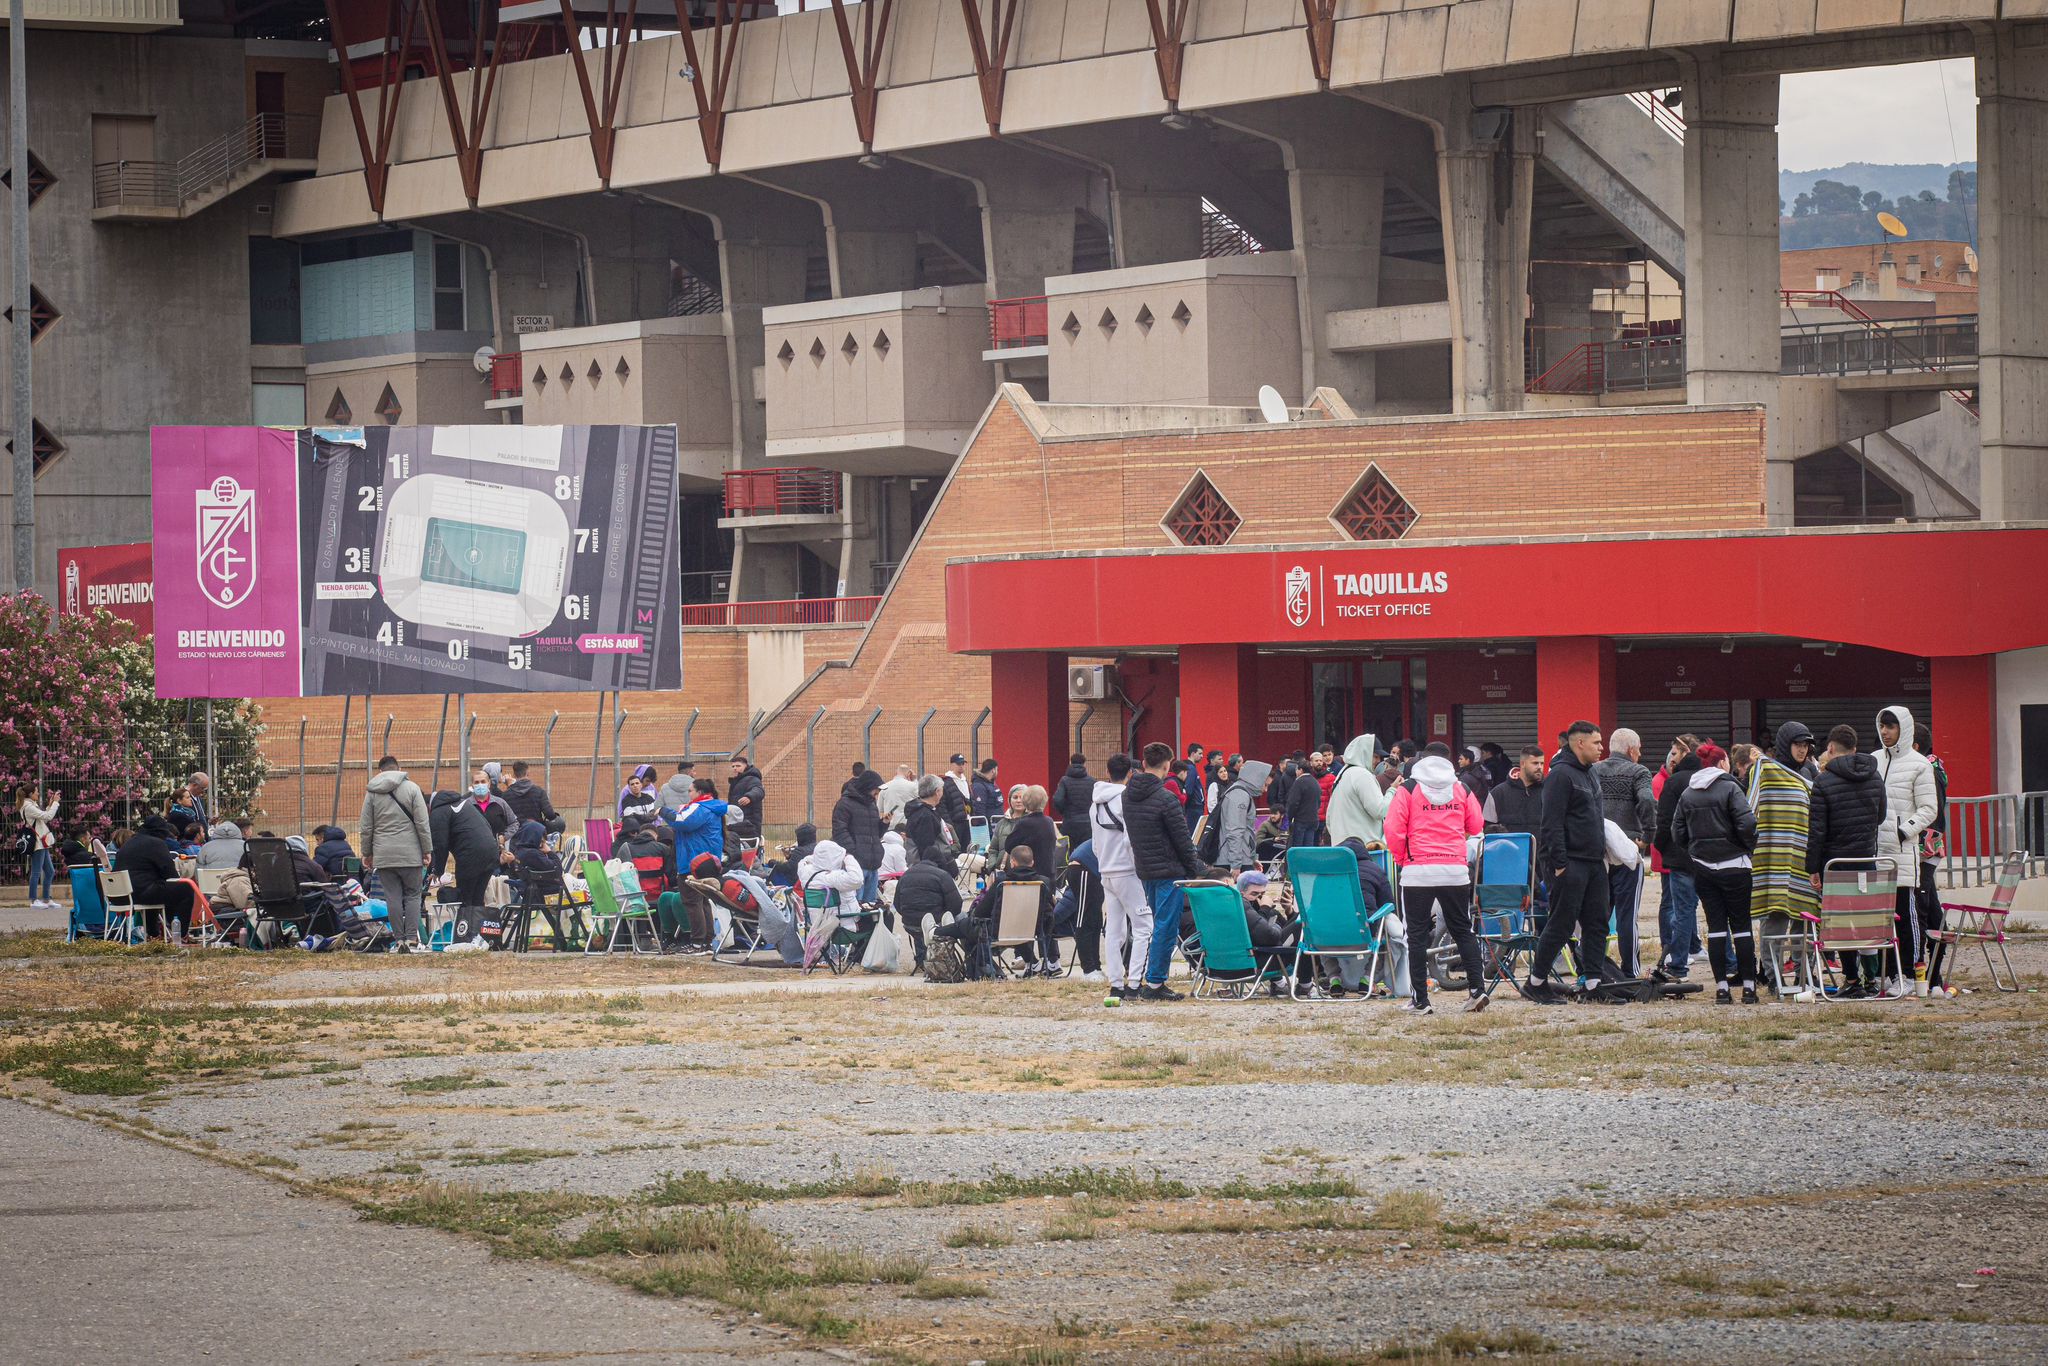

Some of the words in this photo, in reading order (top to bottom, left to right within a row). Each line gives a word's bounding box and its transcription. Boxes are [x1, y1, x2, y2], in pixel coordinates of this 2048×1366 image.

[516, 316, 543, 325] SECTOR
[544, 317, 550, 325] A
[388, 454, 400, 478] 1
[358, 486, 376, 512] 2
[554, 475, 571, 500] 8
[616, 462, 628, 512] COMARES
[322, 504, 337, 569] C/SALVADOR
[332, 456, 344, 501] ALLENDE
[614, 516, 622, 530] DE
[574, 528, 590, 554] 7
[344, 547, 361, 573] 3
[608, 534, 622, 578] C/TORRE
[1334, 571, 1448, 598] TAQUILLAS
[564, 594, 580, 620] 6
[1336, 604, 1382, 618] TICKET
[1384, 603, 1432, 616] OFFICE
[178, 629, 285, 648] BIENVENIDO
[376, 622, 394, 646] 4
[536, 637, 573, 645] TAQUILLA
[584, 636, 614, 648] ESTÁS
[616, 636, 639, 648] AQUÍ
[309, 635, 357, 652] C/PINTOR
[360, 646, 400, 660] MANUEL
[404, 654, 466, 672] MALDONADO
[508, 644, 524, 670] 5
[1493, 669, 1498, 680] 1
[1676, 665, 1685, 676] 3
[1793, 663, 1802, 674] 4
[1916, 661, 1925, 672] 5
